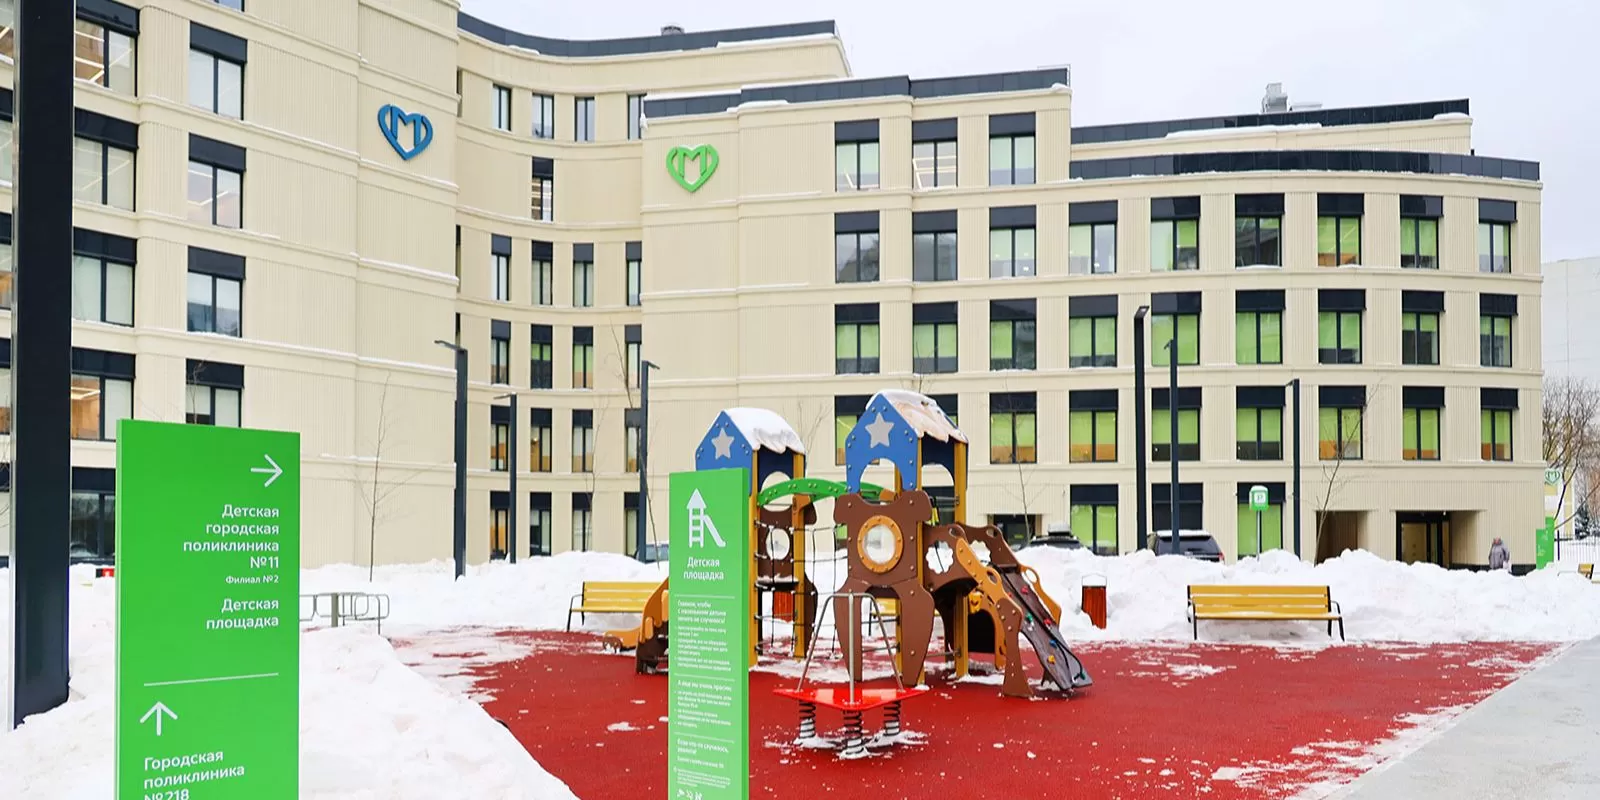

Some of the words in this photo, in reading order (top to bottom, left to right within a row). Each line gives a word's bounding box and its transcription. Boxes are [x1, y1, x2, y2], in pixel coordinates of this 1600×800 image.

[222, 504, 280, 518] Детская
[206, 523, 280, 537] городская
[183, 541, 280, 552] поликлиника
[250, 556, 279, 569] №11
[687, 556, 720, 568] Детская
[225, 575, 261, 584] Филиал
[262, 575, 279, 584] №2
[683, 570, 725, 582] площадка
[221, 598, 279, 613] Детская
[206, 616, 279, 630] площадка
[144, 751, 224, 772] Городская
[144, 765, 245, 790] поликлиника
